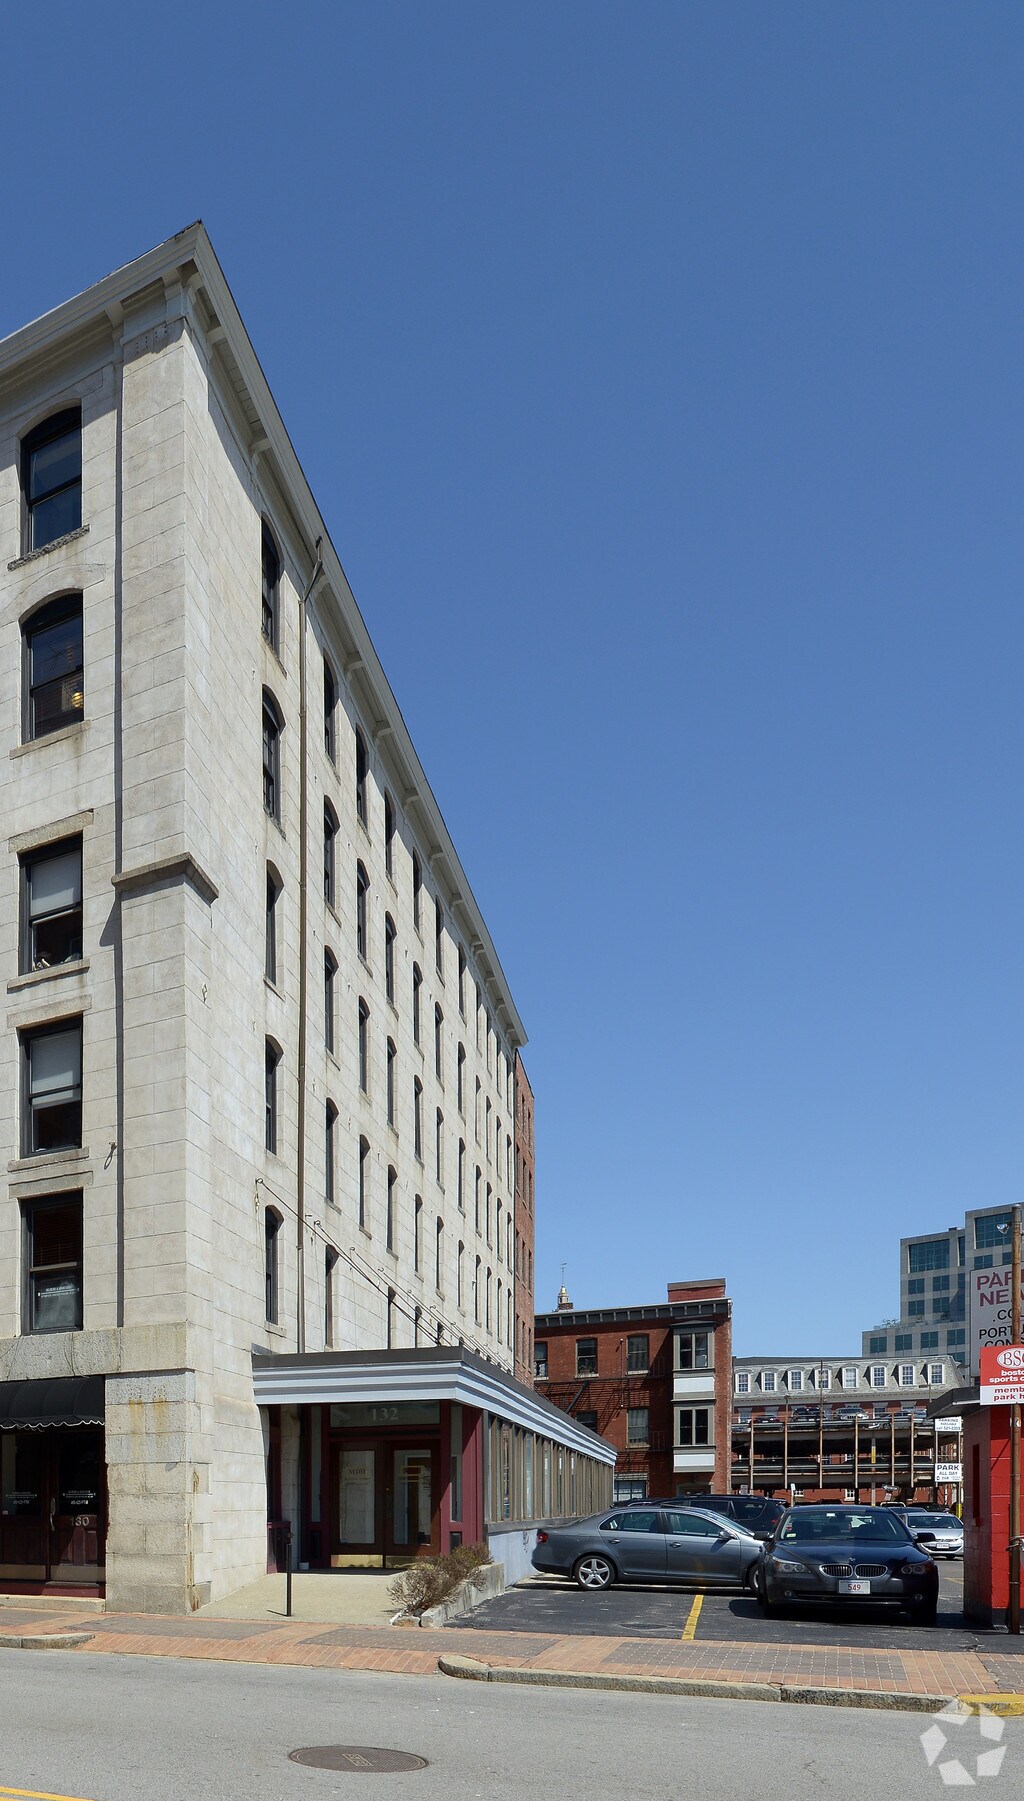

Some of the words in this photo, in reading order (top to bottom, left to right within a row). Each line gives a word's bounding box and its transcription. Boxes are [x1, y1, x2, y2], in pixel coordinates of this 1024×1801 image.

[371, 1407, 399, 1421] 132
[70, 1516, 90, 1526] 130
[847, 1583, 861, 1591] 549
